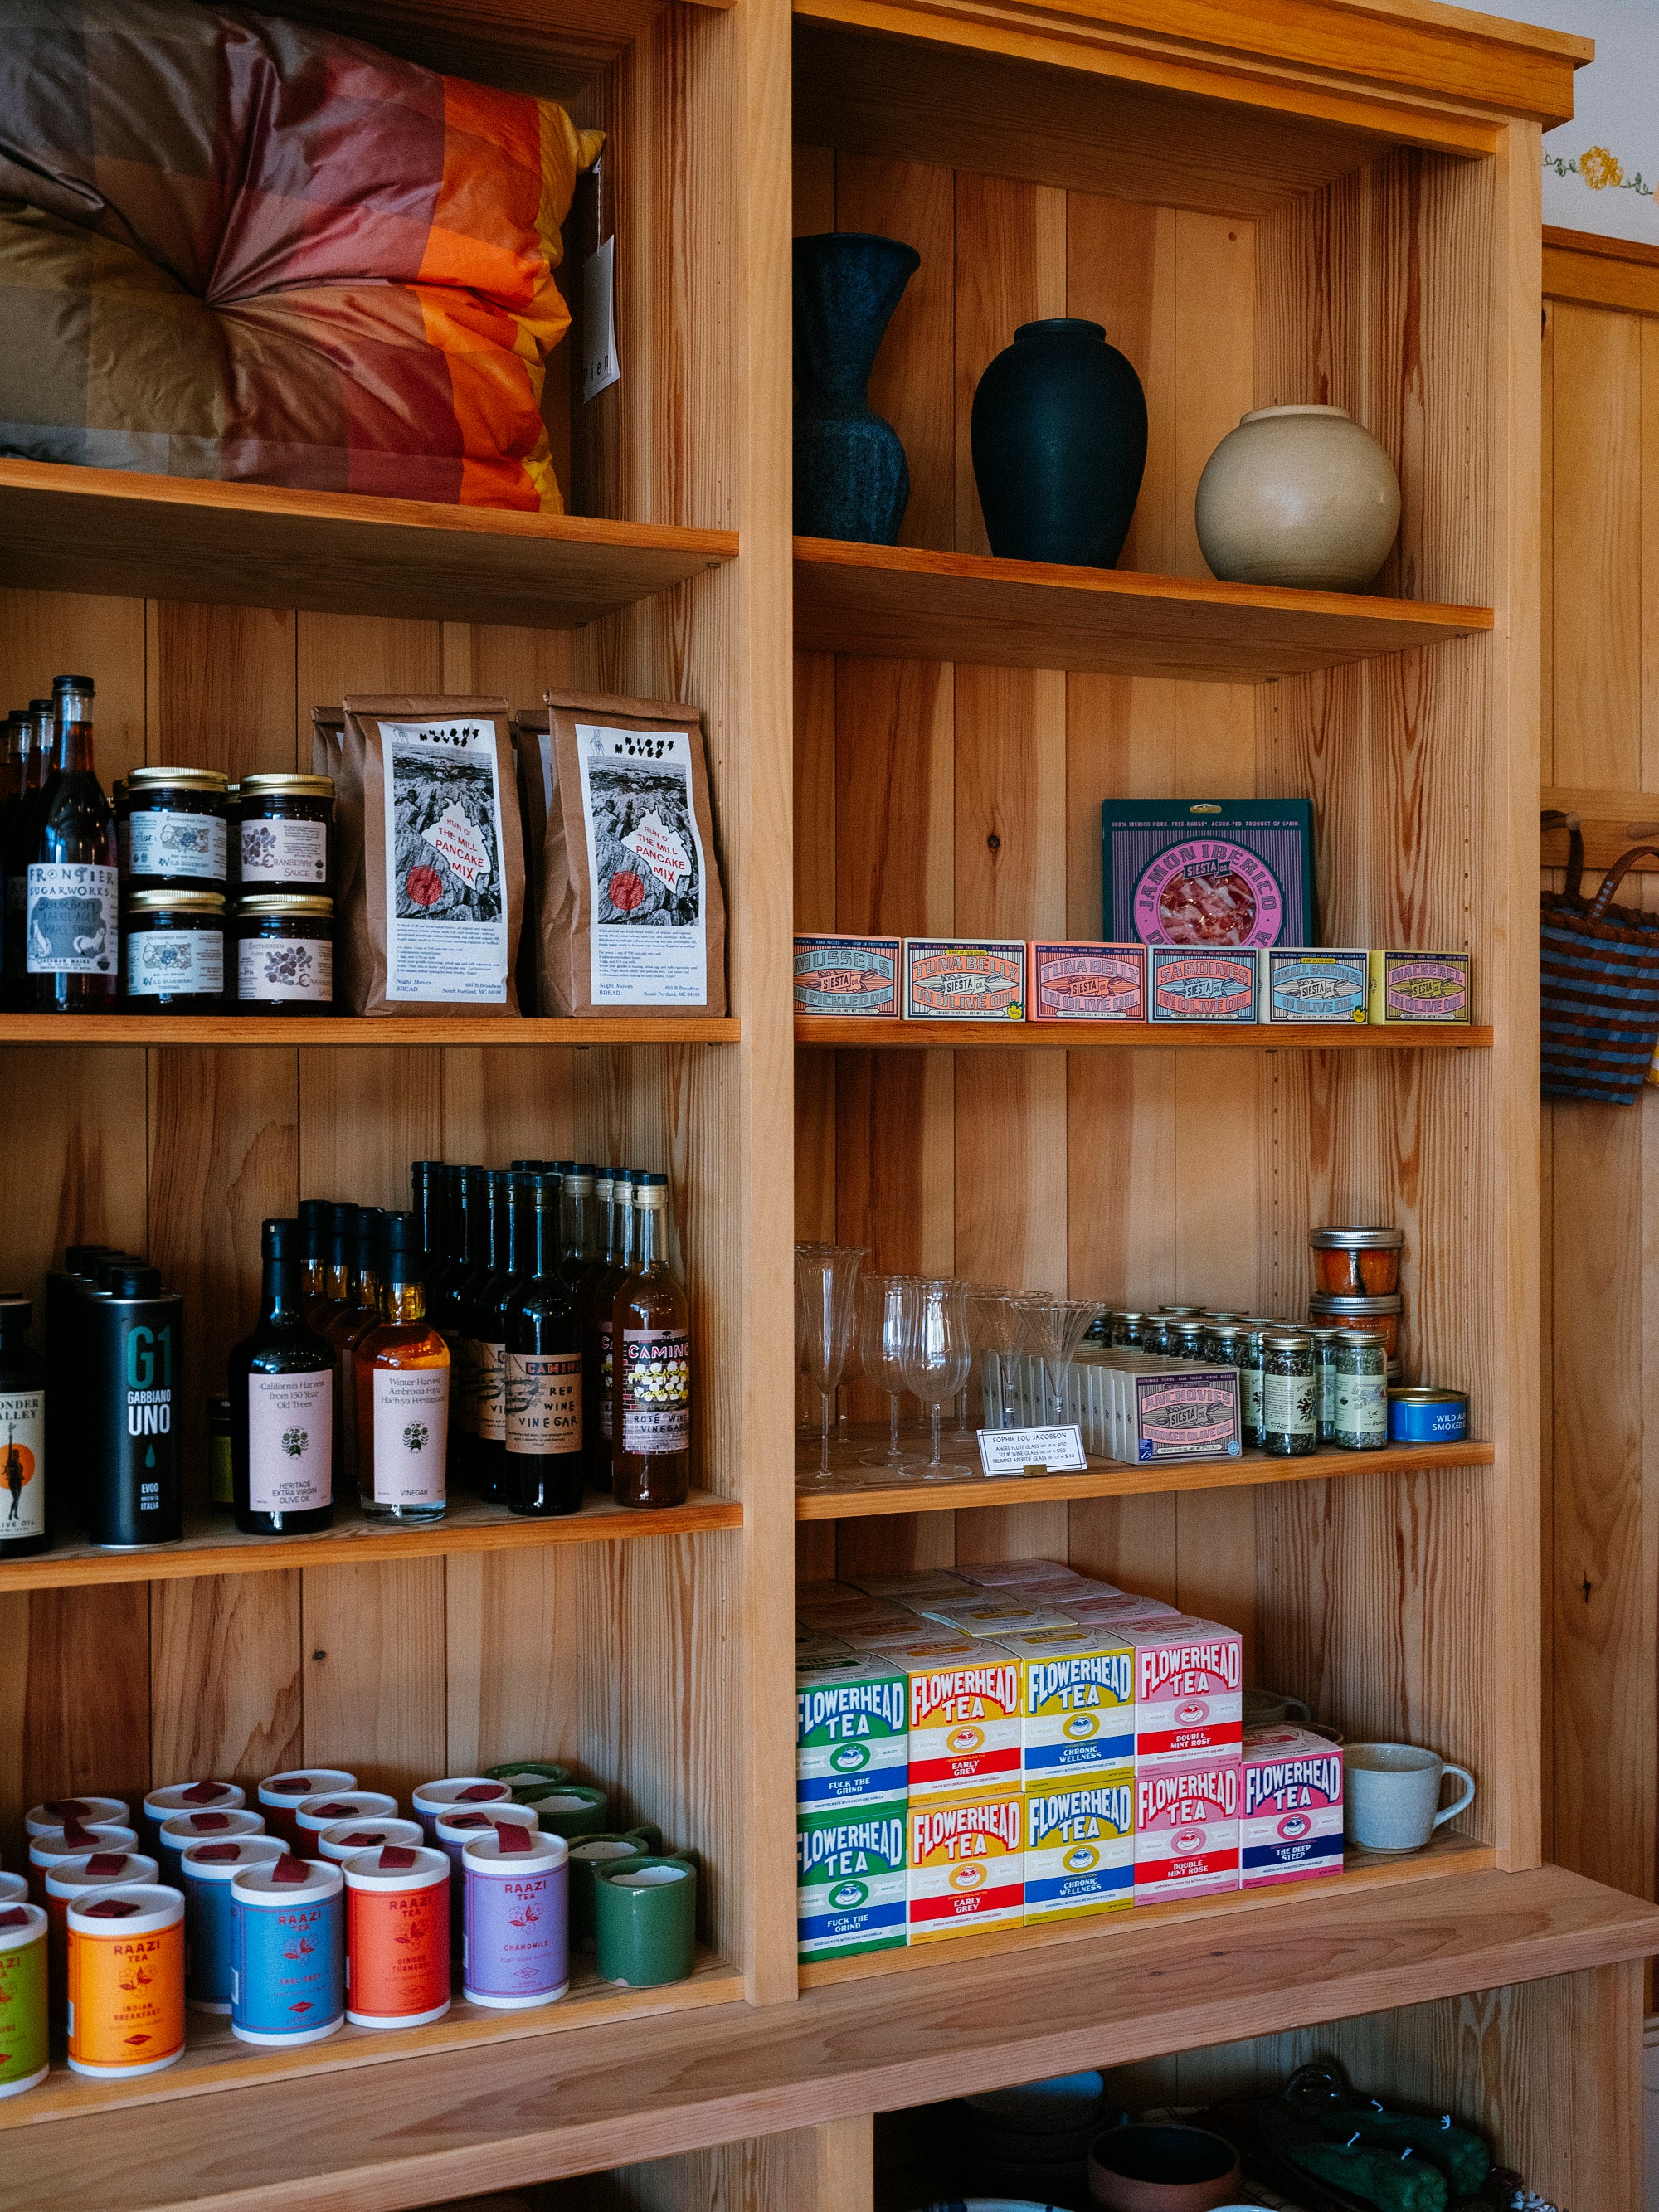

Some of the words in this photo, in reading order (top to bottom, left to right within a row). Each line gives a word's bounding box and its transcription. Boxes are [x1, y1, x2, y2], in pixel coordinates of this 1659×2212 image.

[429, 727, 479, 740] NIGHT
[615, 744, 663, 758] MOVES
[446, 818, 461, 832] RUN
[645, 826, 659, 838] RUN
[439, 827, 455, 840] THE
[458, 836, 478, 852] MILL
[637, 834, 654, 847] THE
[656, 843, 678, 855] MILL
[435, 839, 484, 867] PANCAKE
[636, 846, 684, 869] PANCAKE
[260, 853, 313, 868] CRANBERRY
[284, 868, 310, 877] SAUCE
[452, 863, 474, 882] MIX
[1186, 861, 1217, 876] SIESTA
[654, 867, 675, 885] MIX
[29, 885, 109, 896] SUGARWORKS
[794, 951, 889, 976] MUSSELS
[913, 957, 962, 978] TUNA
[966, 956, 1018, 980] BELLY
[1041, 959, 1087, 980] TUNA
[1089, 959, 1139, 982] BELLY
[1160, 961, 1248, 984] SARDINES
[1274, 967, 1309, 984] SMALL
[1310, 964, 1361, 984] SARDINES
[1391, 965, 1463, 984] MACKEREL
[1187, 982, 1210, 996] SIESTA
[1302, 983, 1324, 997] SIESTA
[1413, 982, 1433, 996] SIESTA
[809, 992, 868, 1006] PICKLED
[916, 988, 933, 1004] IN
[937, 995, 987, 1009] OLIVE
[1160, 992, 1175, 1009] IN
[1178, 999, 1223, 1014] OLIVE
[1225, 994, 1250, 1011] OIL
[1282, 996, 1295, 1009] IN
[1335, 997, 1354, 1011] OIL
[1390, 992, 1404, 1008] IN
[1405, 999, 1443, 1012] OLIVE
[1443, 995, 1463, 1010] OIL
[628, 1342, 688, 1359] CAMINO
[128, 1326, 171, 1390] G1
[260, 1382, 299, 1390] California
[299, 1380, 324, 1389] Harvest
[416, 1378, 441, 1386] Harvest
[128, 1389, 172, 1404] GABBIANO
[269, 1392, 289, 1400] from
[290, 1391, 304, 1399] 150
[304, 1390, 319, 1398] Year
[388, 1387, 425, 1395] Ambrosia
[549, 1386, 572, 1396] RED
[276, 1401, 290, 1409] Old
[381, 1396, 411, 1405] Hachiya
[543, 1400, 575, 1411] WINE
[1145, 1389, 1231, 1411] ANCHOVIES
[128, 1403, 171, 1436] UNO
[519, 1415, 578, 1428] VINEGAR
[634, 1413, 660, 1424] ROSÉ
[1436, 1414, 1457, 1422] WILD
[1432, 1422, 1462, 1431] SMOKED
[992, 1435, 1015, 1443] SOPHIE
[1032, 1432, 1068, 1441] JACOBSON
[1144, 1427, 1186, 1441] SMOKED
[141, 1483, 159, 1493] EVOO
[279, 1480, 311, 1489] HERITAGE
[296, 1487, 317, 1495] VIRGIN
[141, 1502, 159, 1510] ITALIA
[1140, 1642, 1239, 1699] FLOWERHEAD
[1028, 1654, 1131, 1714] FLOWERHEAD
[1170, 1670, 1209, 1696] TEA
[912, 1664, 1018, 1726] FLOWERHEAD
[1058, 1683, 1101, 1709] TEA
[1170, 1741, 1189, 1749] MINT
[1190, 1738, 1212, 1747] ROSE
[1175, 1732, 1206, 1742] DOUBLE
[1059, 1752, 1102, 1763] WELLNESS
[1063, 1745, 1098, 1757] CHRONIC
[951, 1760, 980, 1770] EARLY
[953, 1767, 977, 1777] GREY
[829, 1780, 851, 1790] FUCK
[854, 1777, 871, 1786] THE
[836, 1785, 863, 1795] GRIND
[1245, 1756, 1340, 1815] FLOWERHEAD
[1138, 1768, 1237, 1830] FLOWERHEAD
[1272, 1785, 1311, 1811] TEA
[1028, 1785, 1131, 1846] FLOWERHEAD
[1166, 1800, 1207, 1826] TEA
[913, 1801, 1021, 1864] FLOWERHEAD
[1058, 1815, 1102, 1843] TEA
[943, 1832, 987, 1859] TEA
[1281, 1851, 1306, 1861] STEEP
[1173, 1860, 1203, 1870] DOUBLE
[1188, 1865, 1209, 1874] ROSE
[504, 1879, 547, 1894] RAAZI
[1059, 1883, 1102, 1896] WELLNESS
[1063, 1877, 1098, 1889] CHRONIC
[389, 1896, 432, 1910] RAAZI
[954, 1896, 982, 1908] EARLY
[956, 1903, 980, 1913] GREY
[278, 1910, 322, 1925] RAAZI
[827, 1917, 849, 1928] FUCK
[852, 1914, 869, 1923] THE
[834, 1923, 861, 1932] GRIND
[114, 1939, 160, 1956] RAAZI
[504, 1939, 549, 1951] CHAMOMILE
